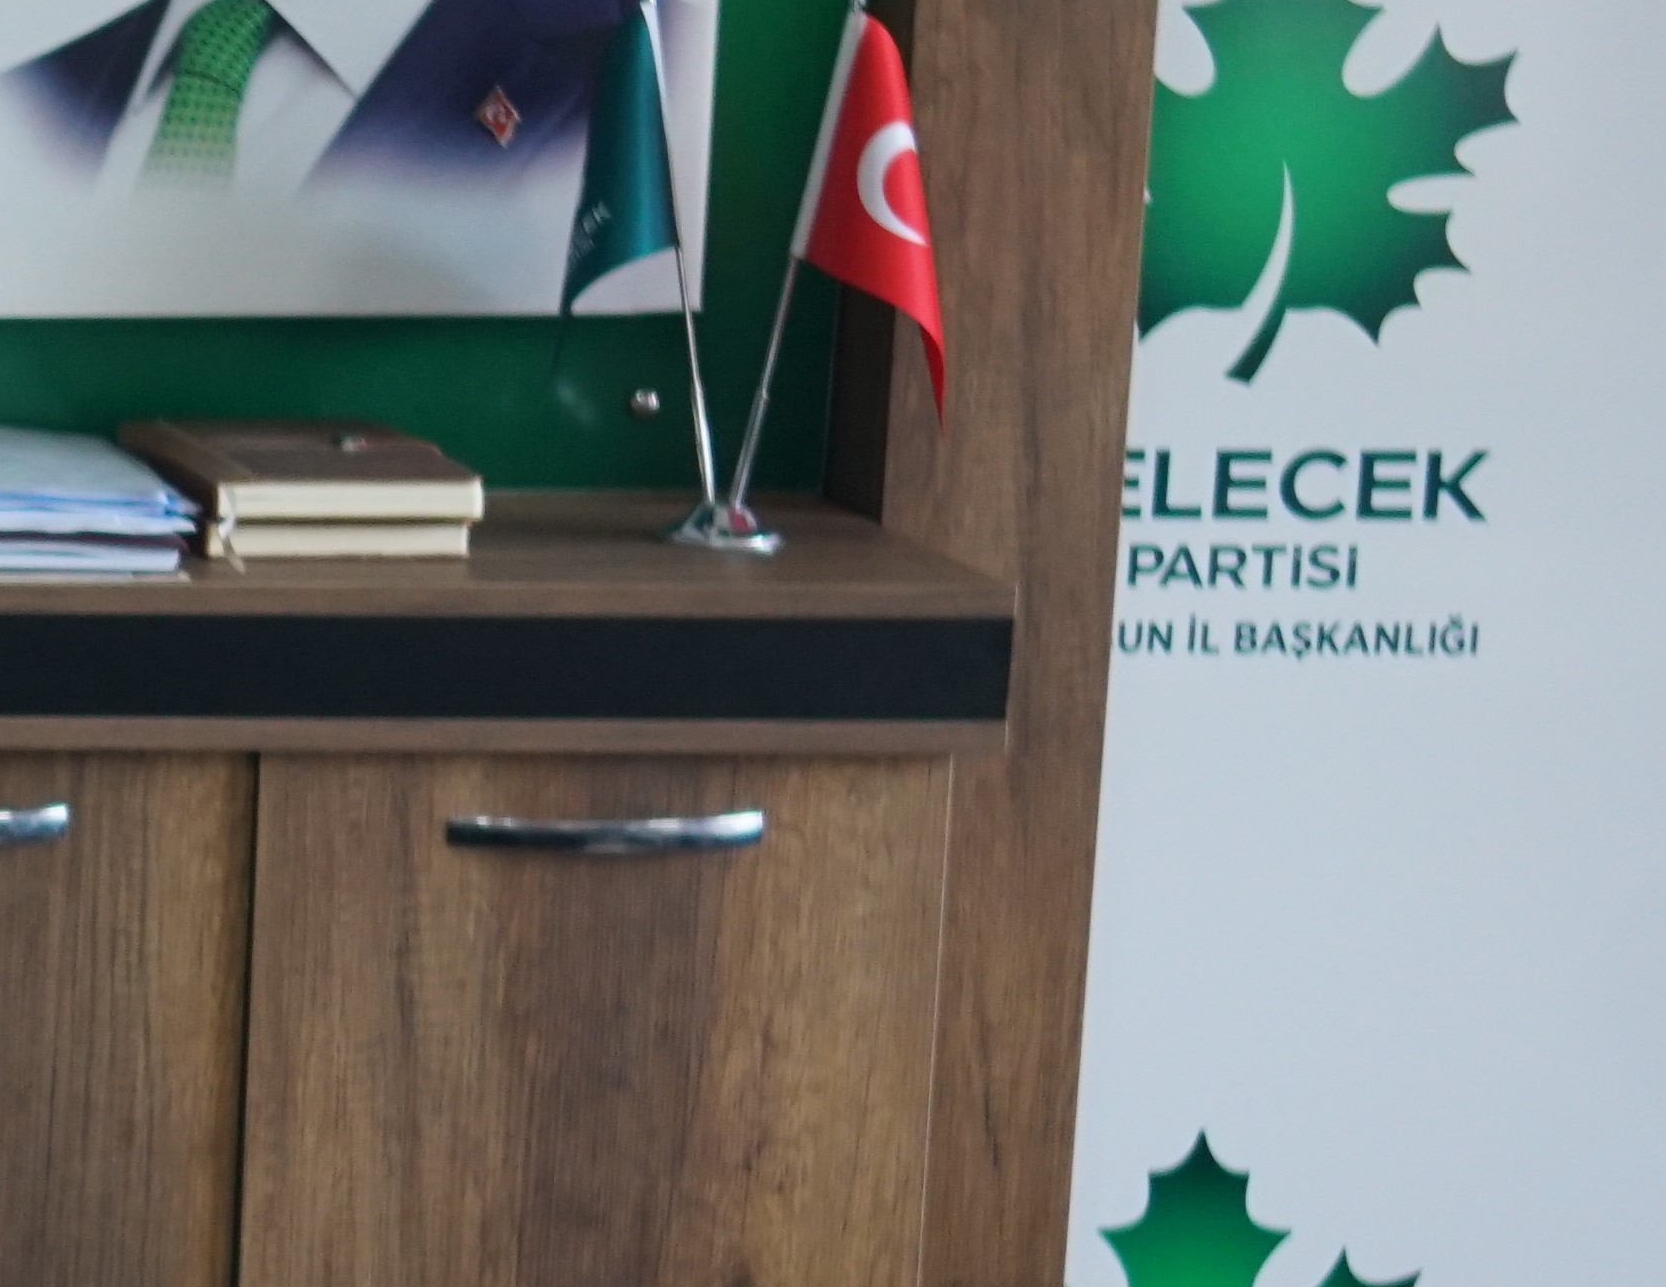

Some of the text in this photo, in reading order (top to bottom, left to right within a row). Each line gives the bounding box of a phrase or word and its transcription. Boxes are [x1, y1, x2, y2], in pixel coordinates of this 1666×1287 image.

[1122, 446, 1490, 522] LECEK
[1187, 613, 1219, 655] İL
[1234, 613, 1480, 660] BAŞKANLIĞI
